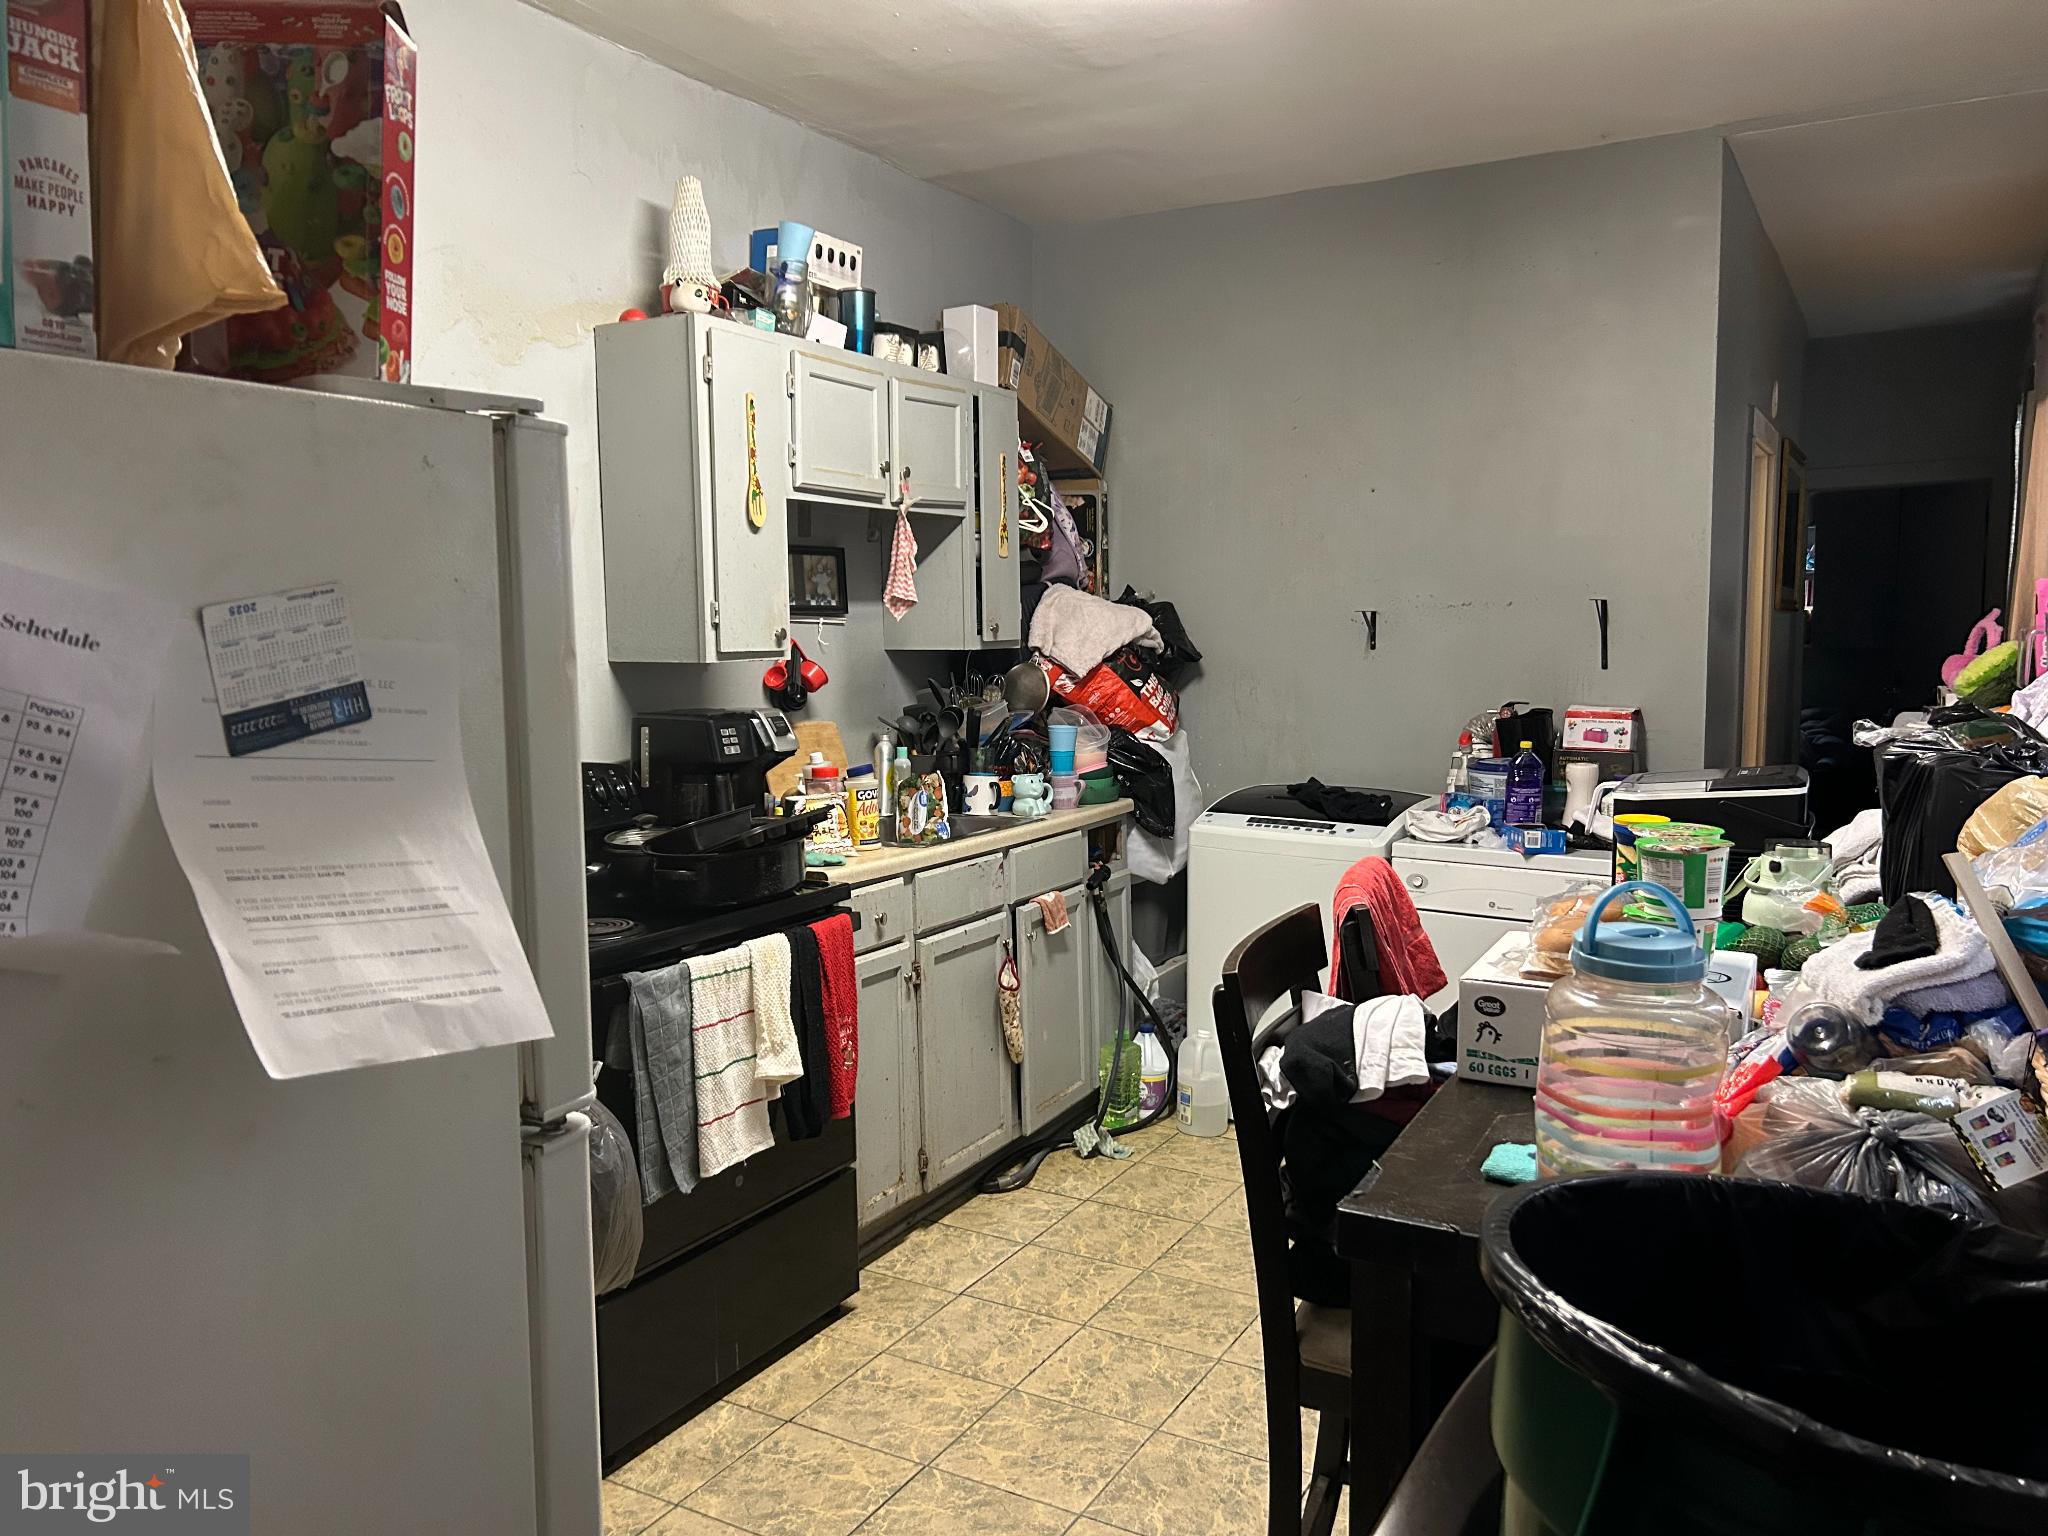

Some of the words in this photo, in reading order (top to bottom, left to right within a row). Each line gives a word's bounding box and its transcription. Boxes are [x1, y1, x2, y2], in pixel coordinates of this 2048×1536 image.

[9, 16, 77, 50] HUNGRY
[8, 31, 81, 73] JACK
[18, 155, 80, 184] PANCAKES
[14, 175, 44, 195] MAKE
[48, 182, 84, 205] PEOPLE
[27, 195, 76, 217] HAPPY
[385, 280, 407, 302] YOUR
[386, 295, 408, 317] NOSE
[0, 613, 100, 651] Schedule
[1140, 672, 1158, 698] THIS
[1148, 684, 1164, 709] BAG
[29, 702, 75, 720] Page(s)
[26, 719, 40, 731] 93
[13, 765, 27, 777] 97
[857, 789, 878, 801] GOY
[14, 808, 33, 820] 100
[5, 826, 20, 837] 101
[7, 838, 25, 850] 102
[0, 857, 13, 868] 03
[1477, 999, 1501, 1010] Great
[1468, 1061, 1484, 1074] 60
[1488, 1064, 1517, 1078] EGGS
